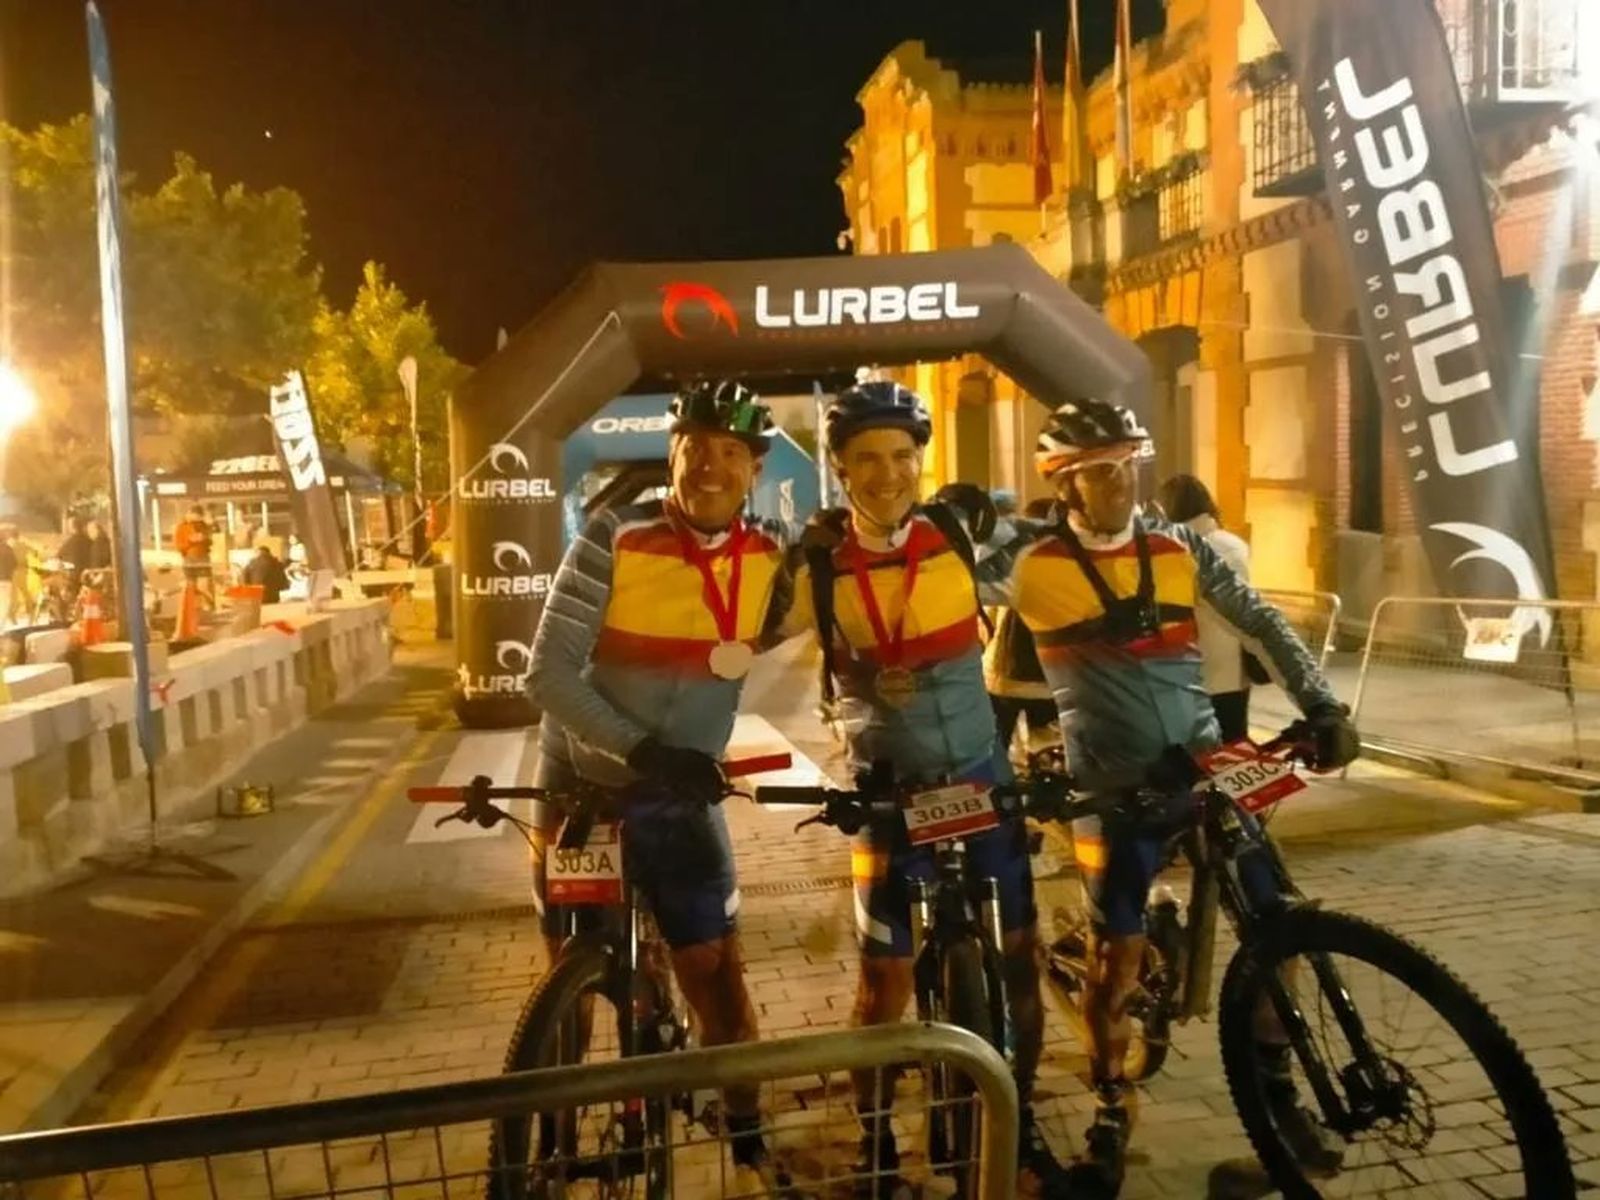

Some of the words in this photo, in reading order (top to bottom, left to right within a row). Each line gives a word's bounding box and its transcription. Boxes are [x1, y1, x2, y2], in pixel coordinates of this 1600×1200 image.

[755, 282, 980, 328] LURBEL
[592, 415, 668, 434] ORB
[459, 477, 556, 499] LURBEL
[1224, 763, 1280, 792] 303C
[912, 797, 983, 824] 303B
[555, 851, 615, 874] 303A
